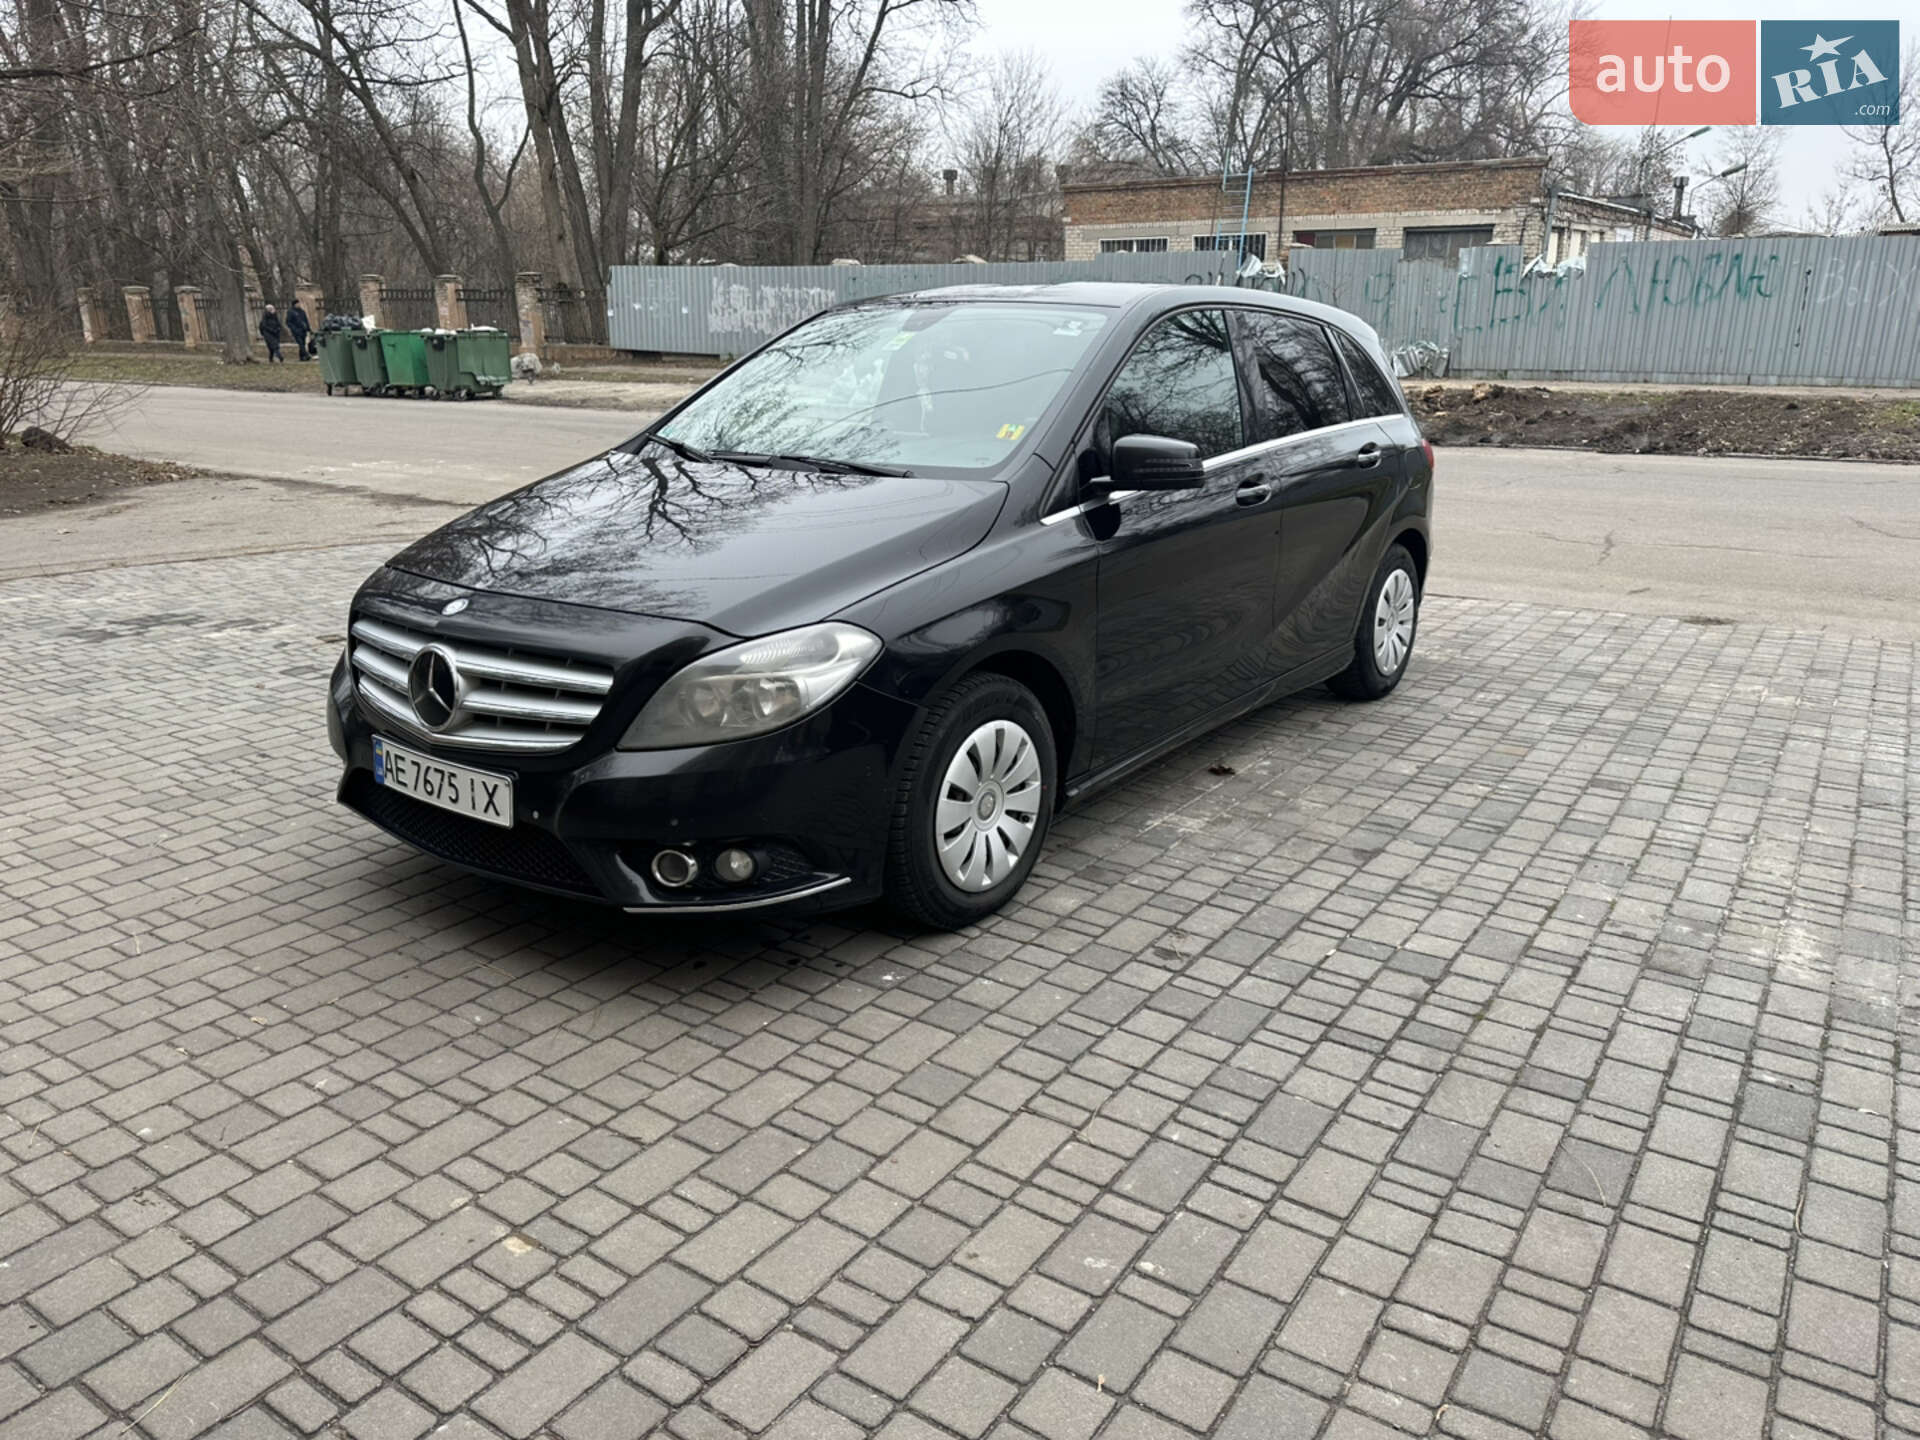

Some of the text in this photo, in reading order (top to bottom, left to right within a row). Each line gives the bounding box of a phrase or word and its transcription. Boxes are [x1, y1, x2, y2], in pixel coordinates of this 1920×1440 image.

[384, 750, 500, 817] AE 7675 IX
